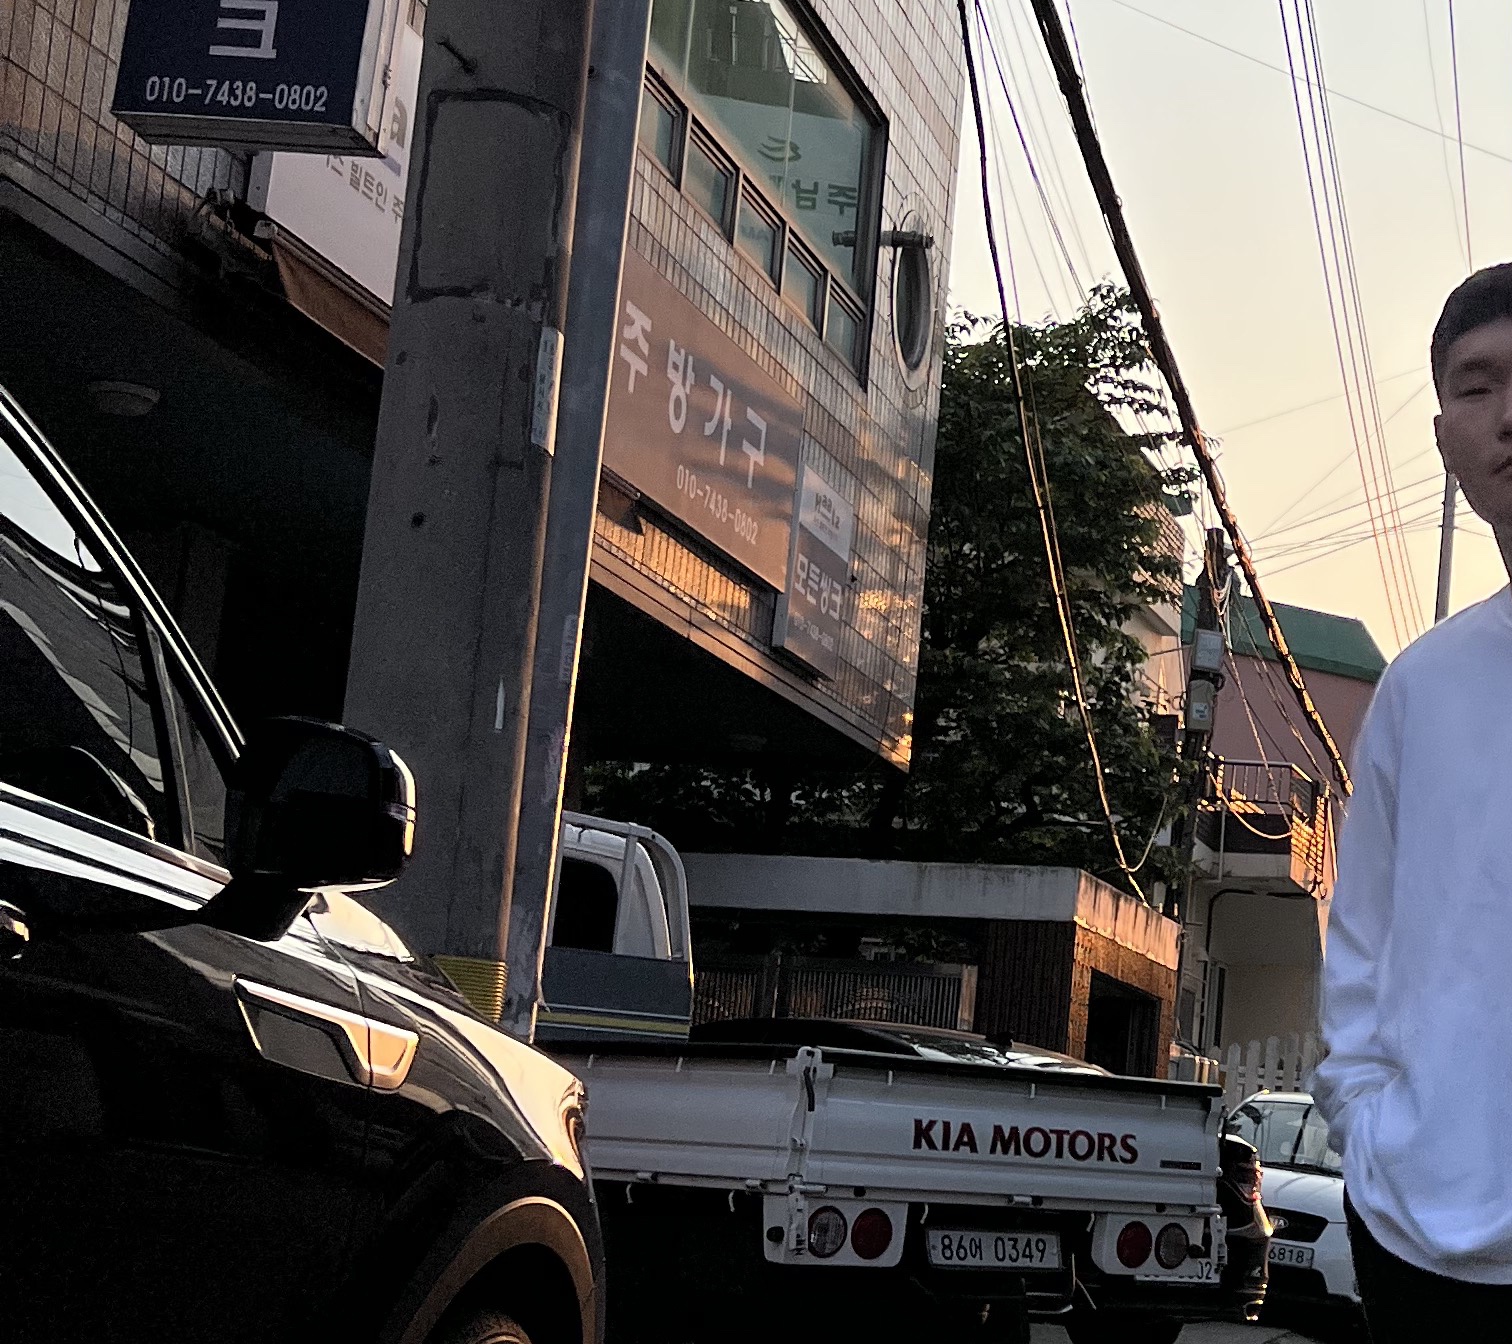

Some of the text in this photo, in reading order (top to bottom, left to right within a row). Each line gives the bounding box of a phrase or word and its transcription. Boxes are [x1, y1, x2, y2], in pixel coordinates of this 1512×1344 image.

[145, 75, 329, 113] 010-7438-0802
[350, 160, 388, 213] 빌트인
[620, 299, 768, 489] 주방가구
[675, 463, 760, 547] 010-7438-0802
[794, 553, 843, 622] 모든씽크
[912, 1118, 1138, 1165] KIA MOTORS
[941, 1233, 1047, 1263] 86어 0349
[1267, 1246, 1305, 1264] 6818
